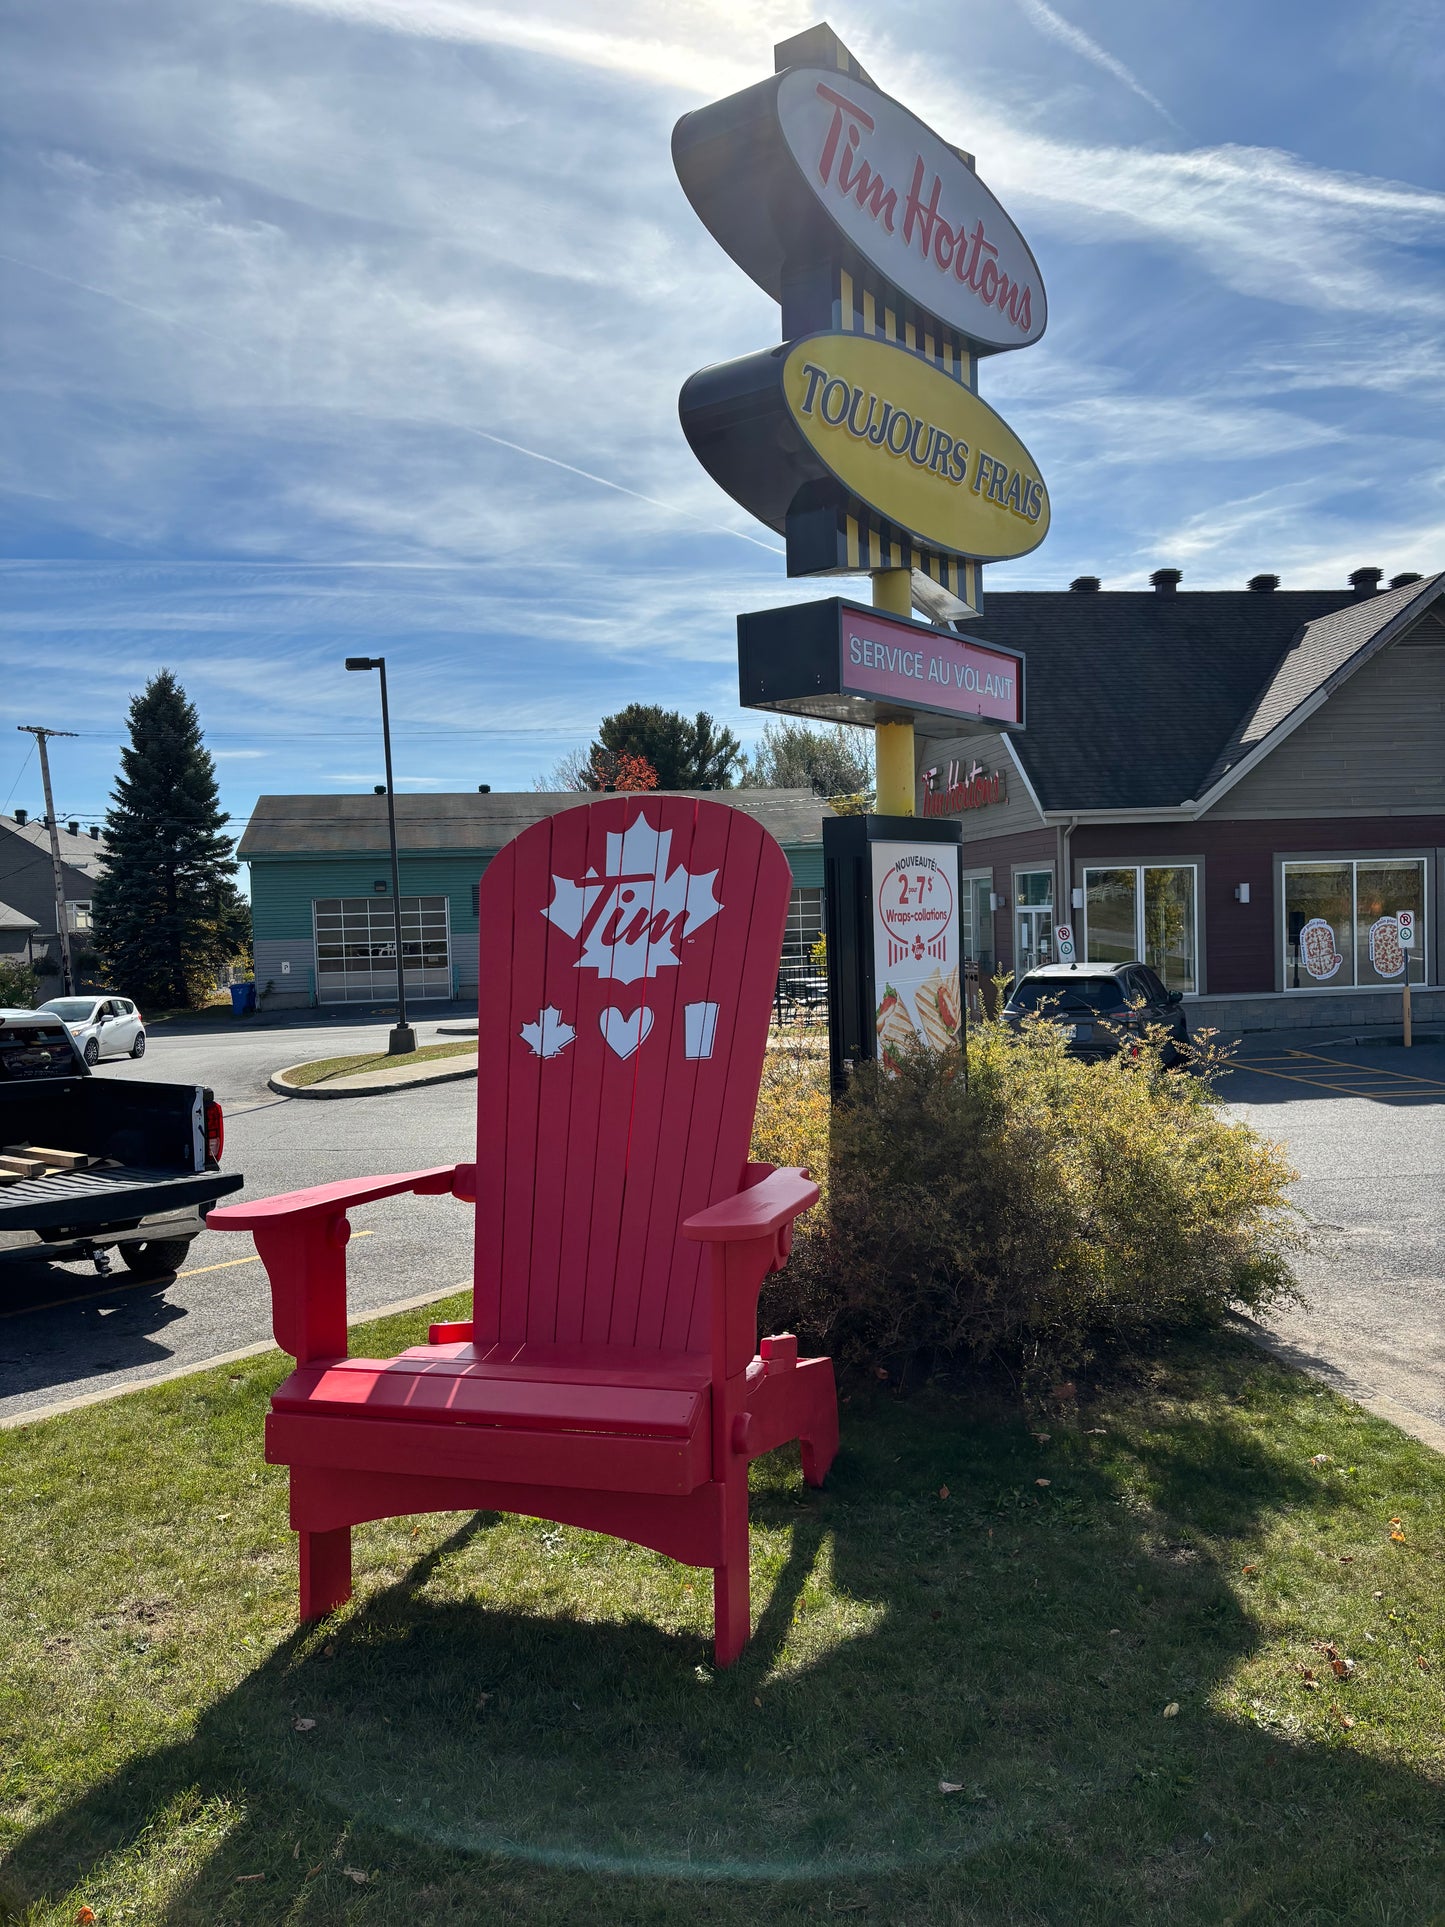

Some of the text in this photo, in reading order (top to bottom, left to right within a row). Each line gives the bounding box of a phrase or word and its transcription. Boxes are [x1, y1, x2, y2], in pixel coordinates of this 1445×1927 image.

[816, 82, 1032, 332] Tim Hortons
[801, 363, 1045, 521] TOUJOURS FRAIS
[850, 636, 1014, 700] SERVICE AU VOLANT
[895, 855, 938, 873] NOUVEAUTÉ!
[898, 874, 909, 904] 2
[574, 873, 690, 946] Tim
[886, 907, 947, 925] Wraps-collations
